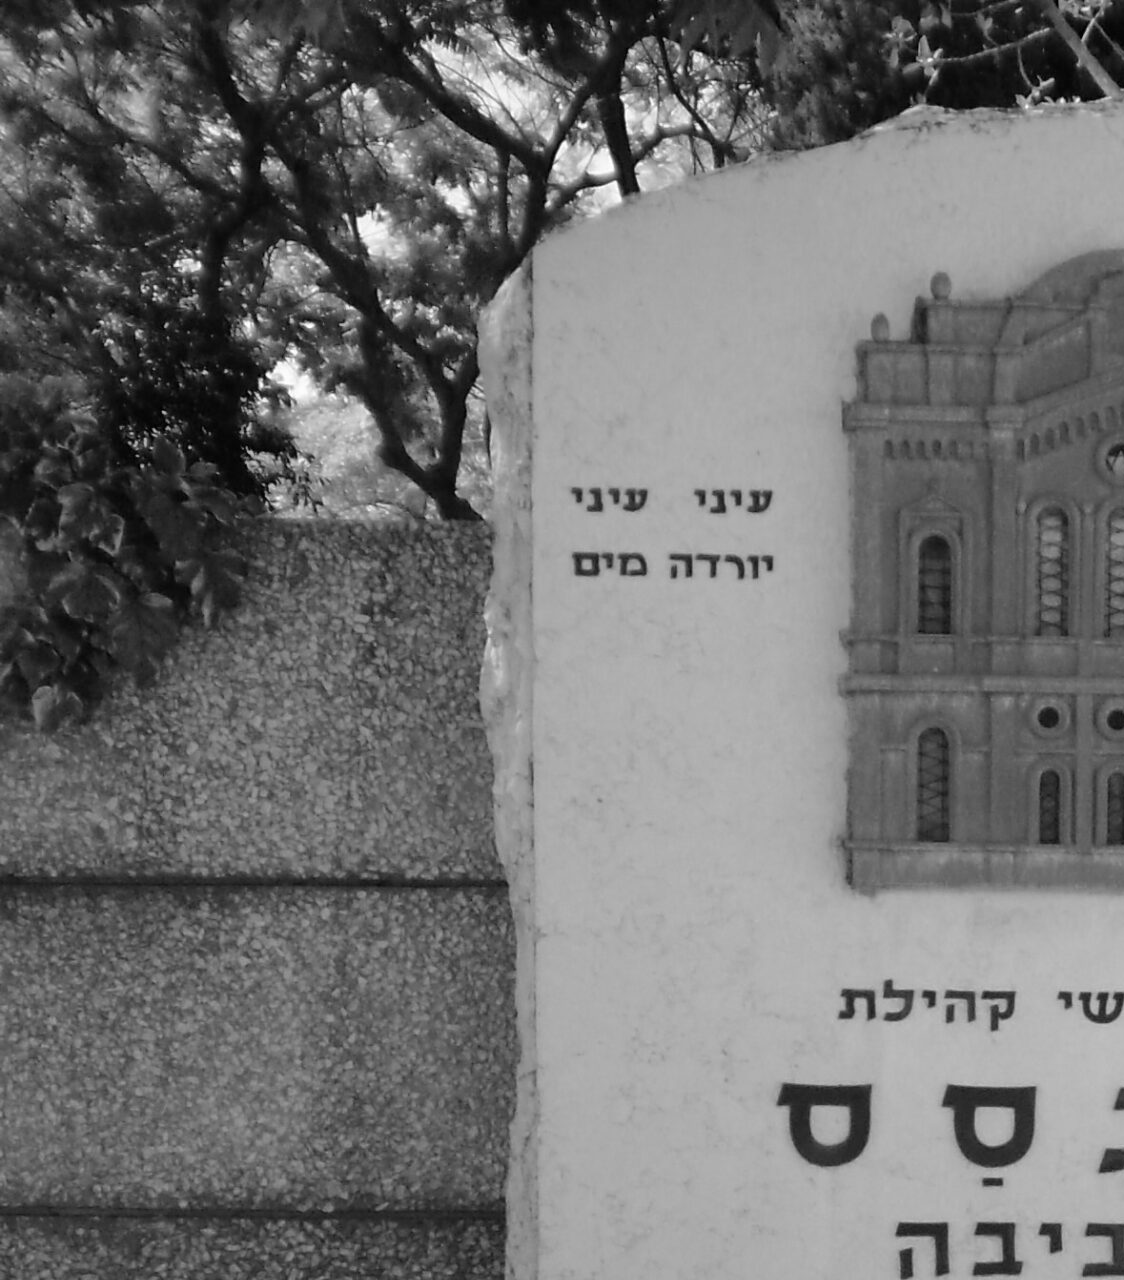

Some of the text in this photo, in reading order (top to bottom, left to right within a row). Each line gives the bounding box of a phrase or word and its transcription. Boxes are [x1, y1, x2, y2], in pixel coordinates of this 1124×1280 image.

[570, 487, 773, 514] עיני עיני
[572, 551, 774, 580] יורדה מים
[837, 979, 1017, 1032] קהילת
